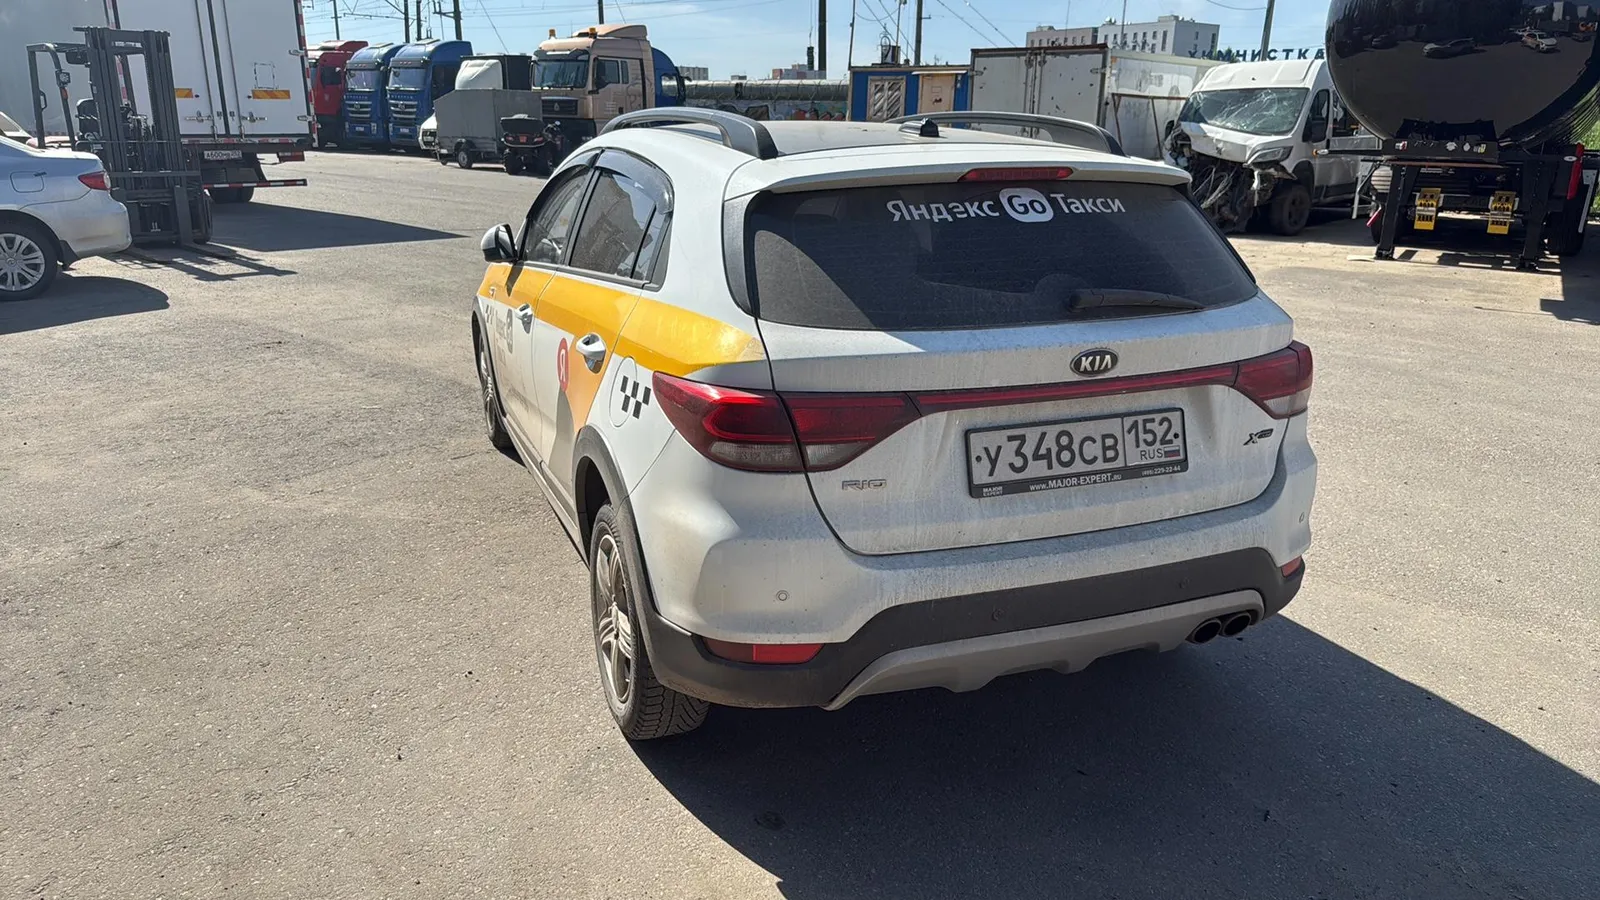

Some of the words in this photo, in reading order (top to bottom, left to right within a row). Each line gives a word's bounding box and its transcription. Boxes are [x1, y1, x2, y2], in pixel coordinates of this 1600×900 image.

[886, 200, 999, 222] Яндекс
[1006, 194, 1047, 215] Go
[1050, 193, 1125, 214] Такси
[1080, 354, 1112, 372] KIA
[983, 429, 1119, 477] У348СВ
[1126, 416, 1174, 449] 152
[1140, 448, 1164, 460] RUS
[841, 479, 888, 491] RIO
